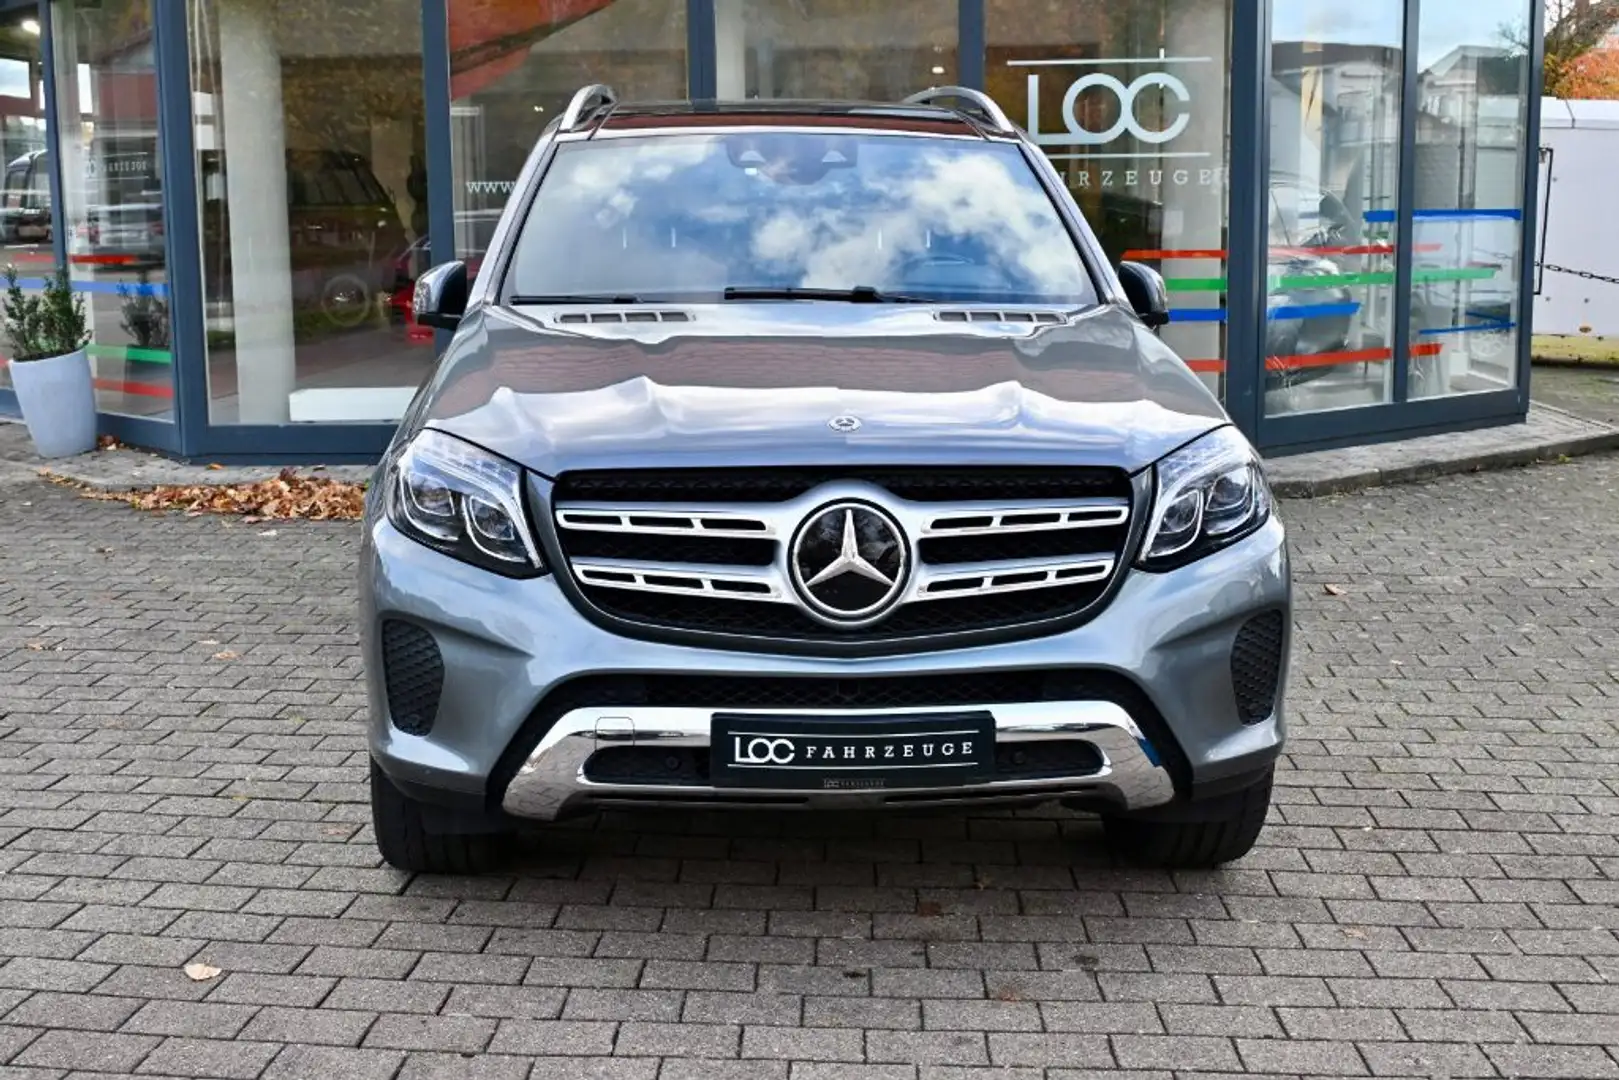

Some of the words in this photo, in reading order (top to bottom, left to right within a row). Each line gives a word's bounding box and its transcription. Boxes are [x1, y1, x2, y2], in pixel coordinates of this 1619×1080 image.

[1027, 72, 1190, 145] LOC
[735, 736, 795, 764] LOC
[806, 741, 973, 759] FAHRZEUGE
